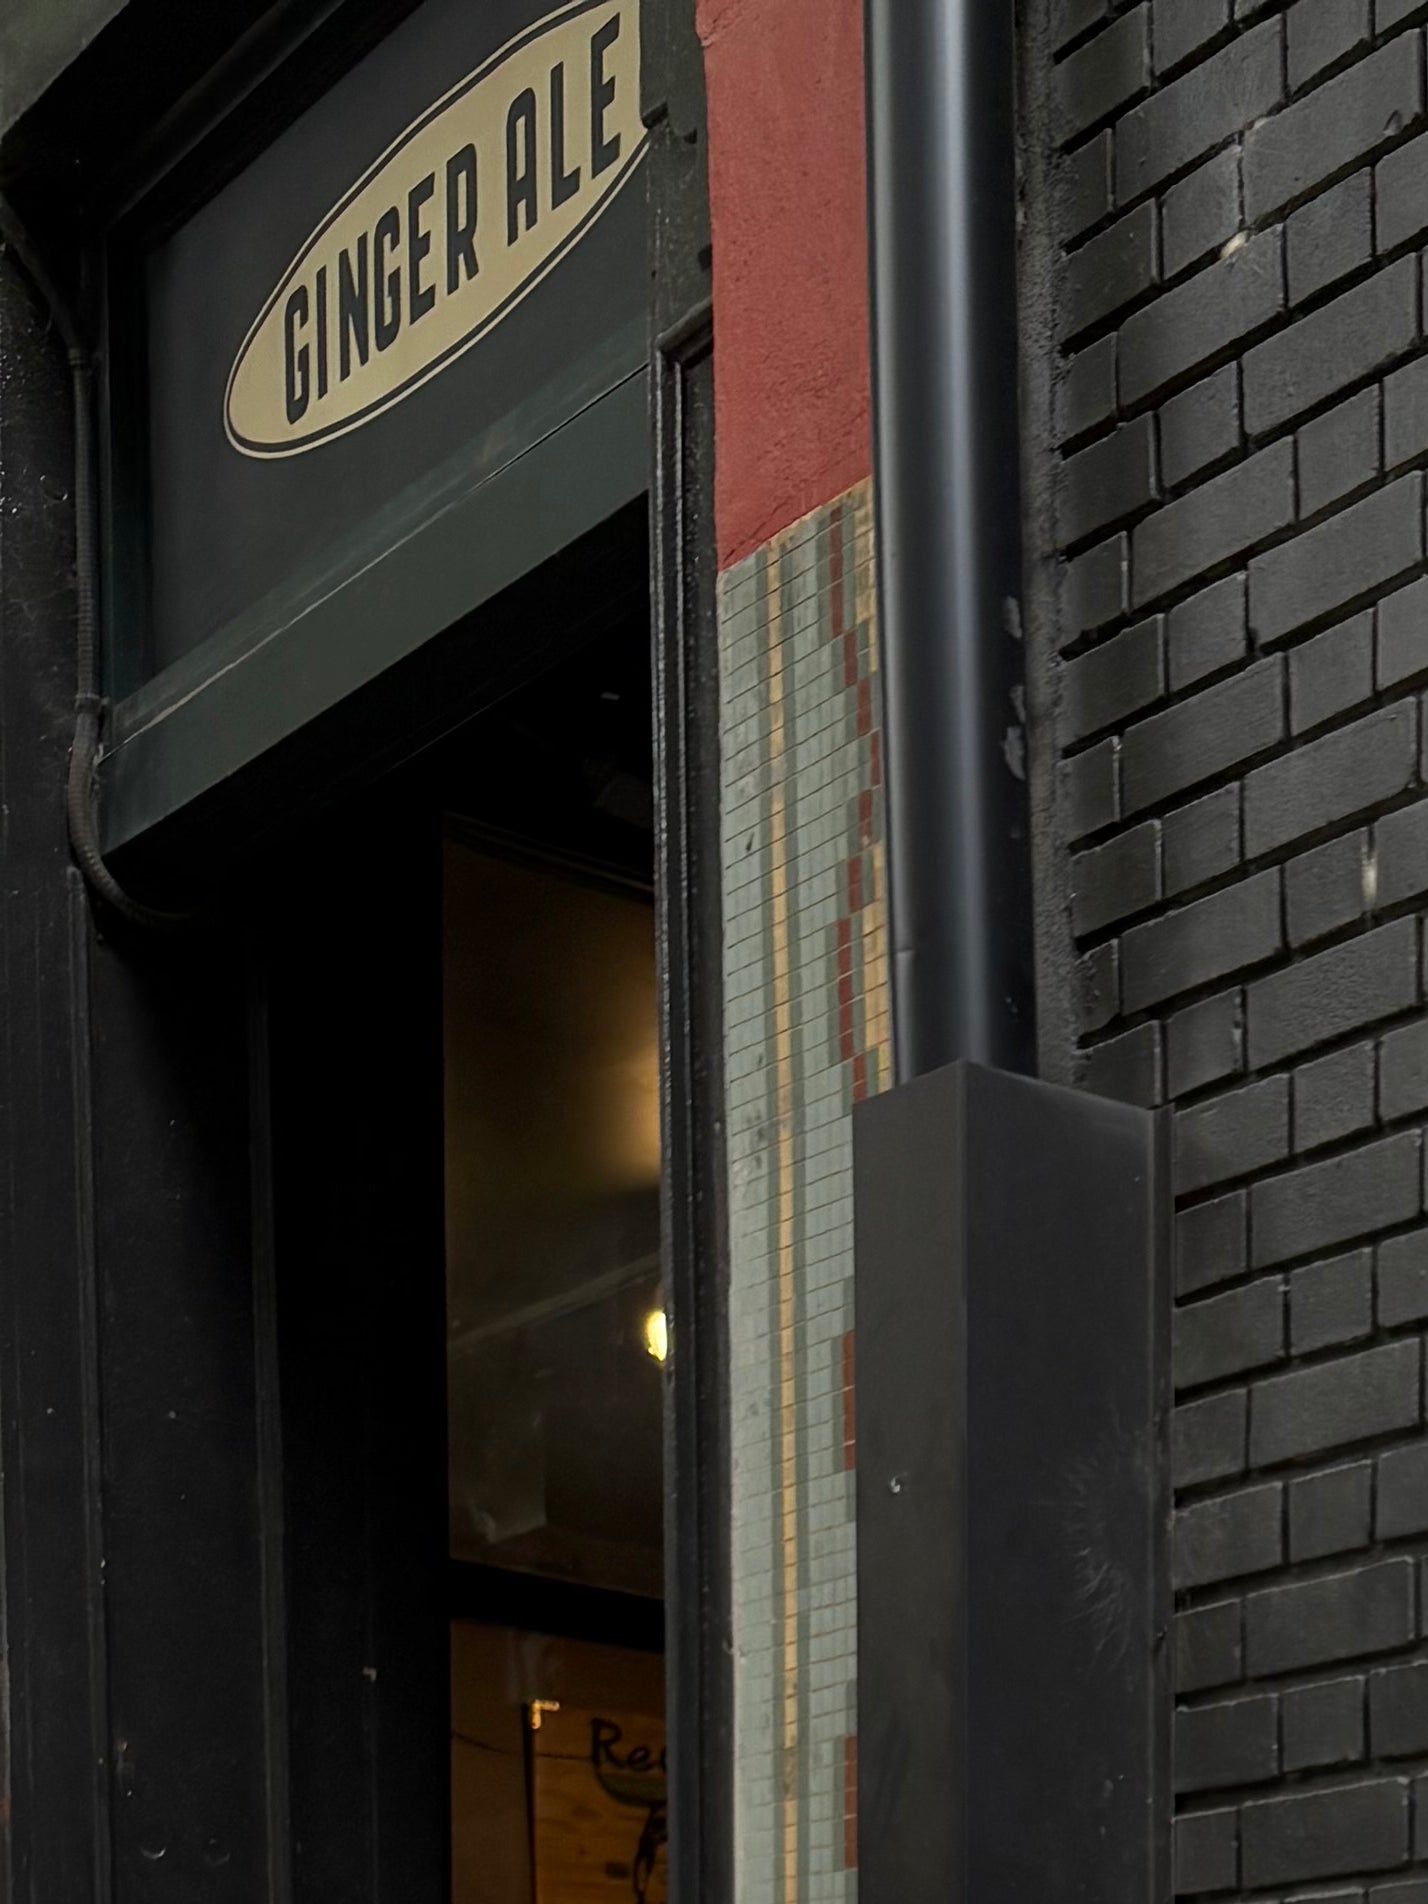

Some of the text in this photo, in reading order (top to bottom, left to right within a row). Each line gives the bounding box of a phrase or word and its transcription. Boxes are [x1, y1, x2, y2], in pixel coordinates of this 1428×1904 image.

[284, 13, 620, 425] GINGER ALE
[589, 1717, 666, 1774] Re
